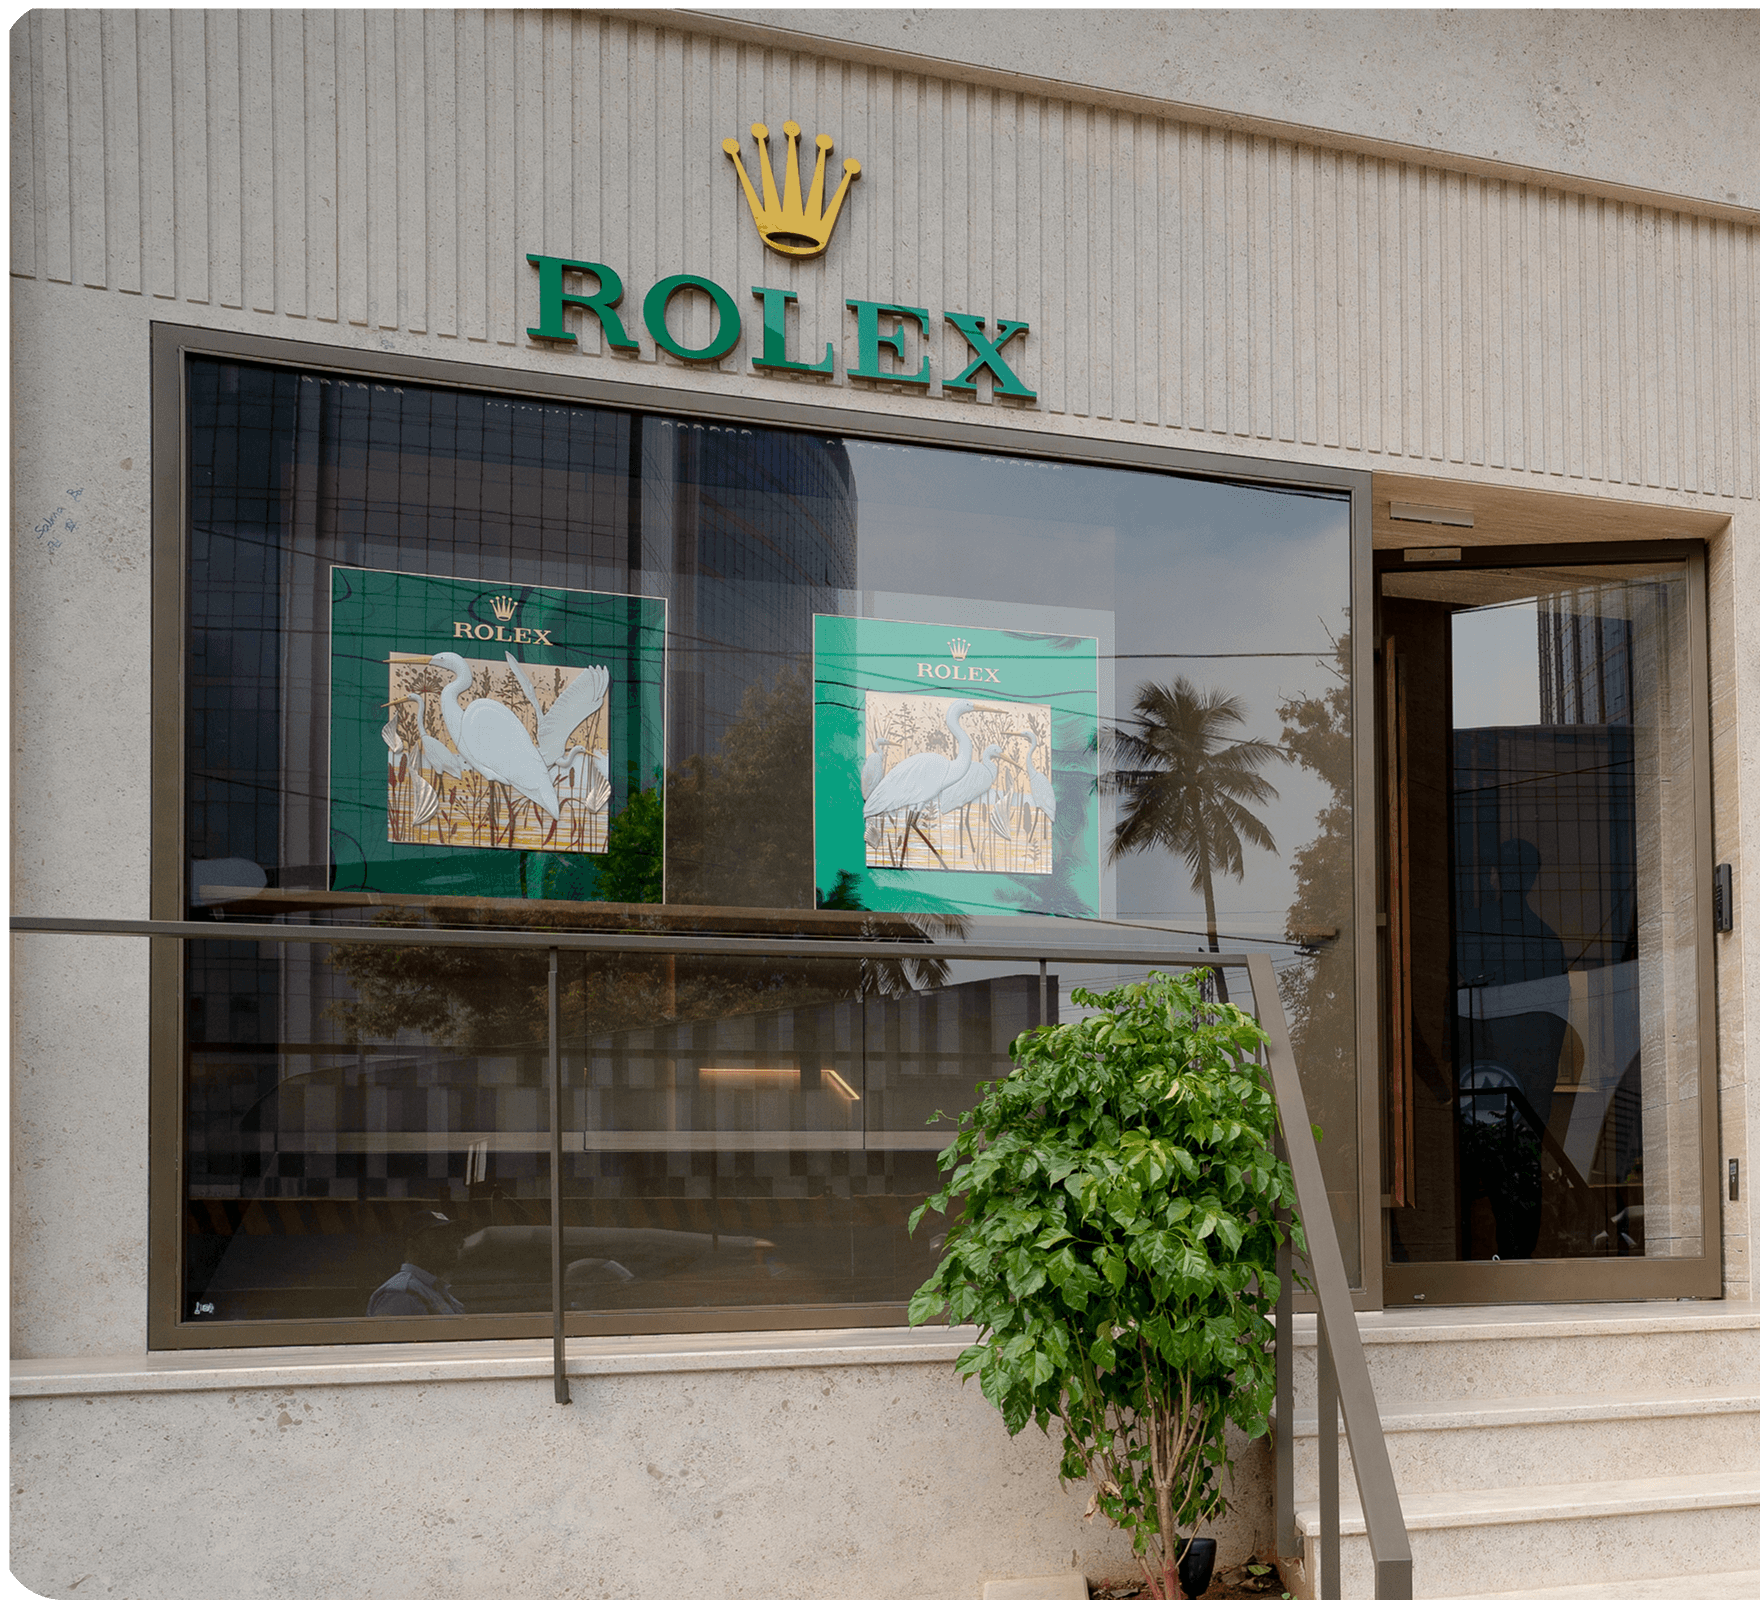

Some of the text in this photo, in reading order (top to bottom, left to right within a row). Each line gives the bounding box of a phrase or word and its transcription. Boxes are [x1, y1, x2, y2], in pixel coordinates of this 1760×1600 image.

[526, 253, 1038, 401] ROLEX
[453, 621, 553, 646] ROLEX
[916, 662, 1002, 683] ROLEX
